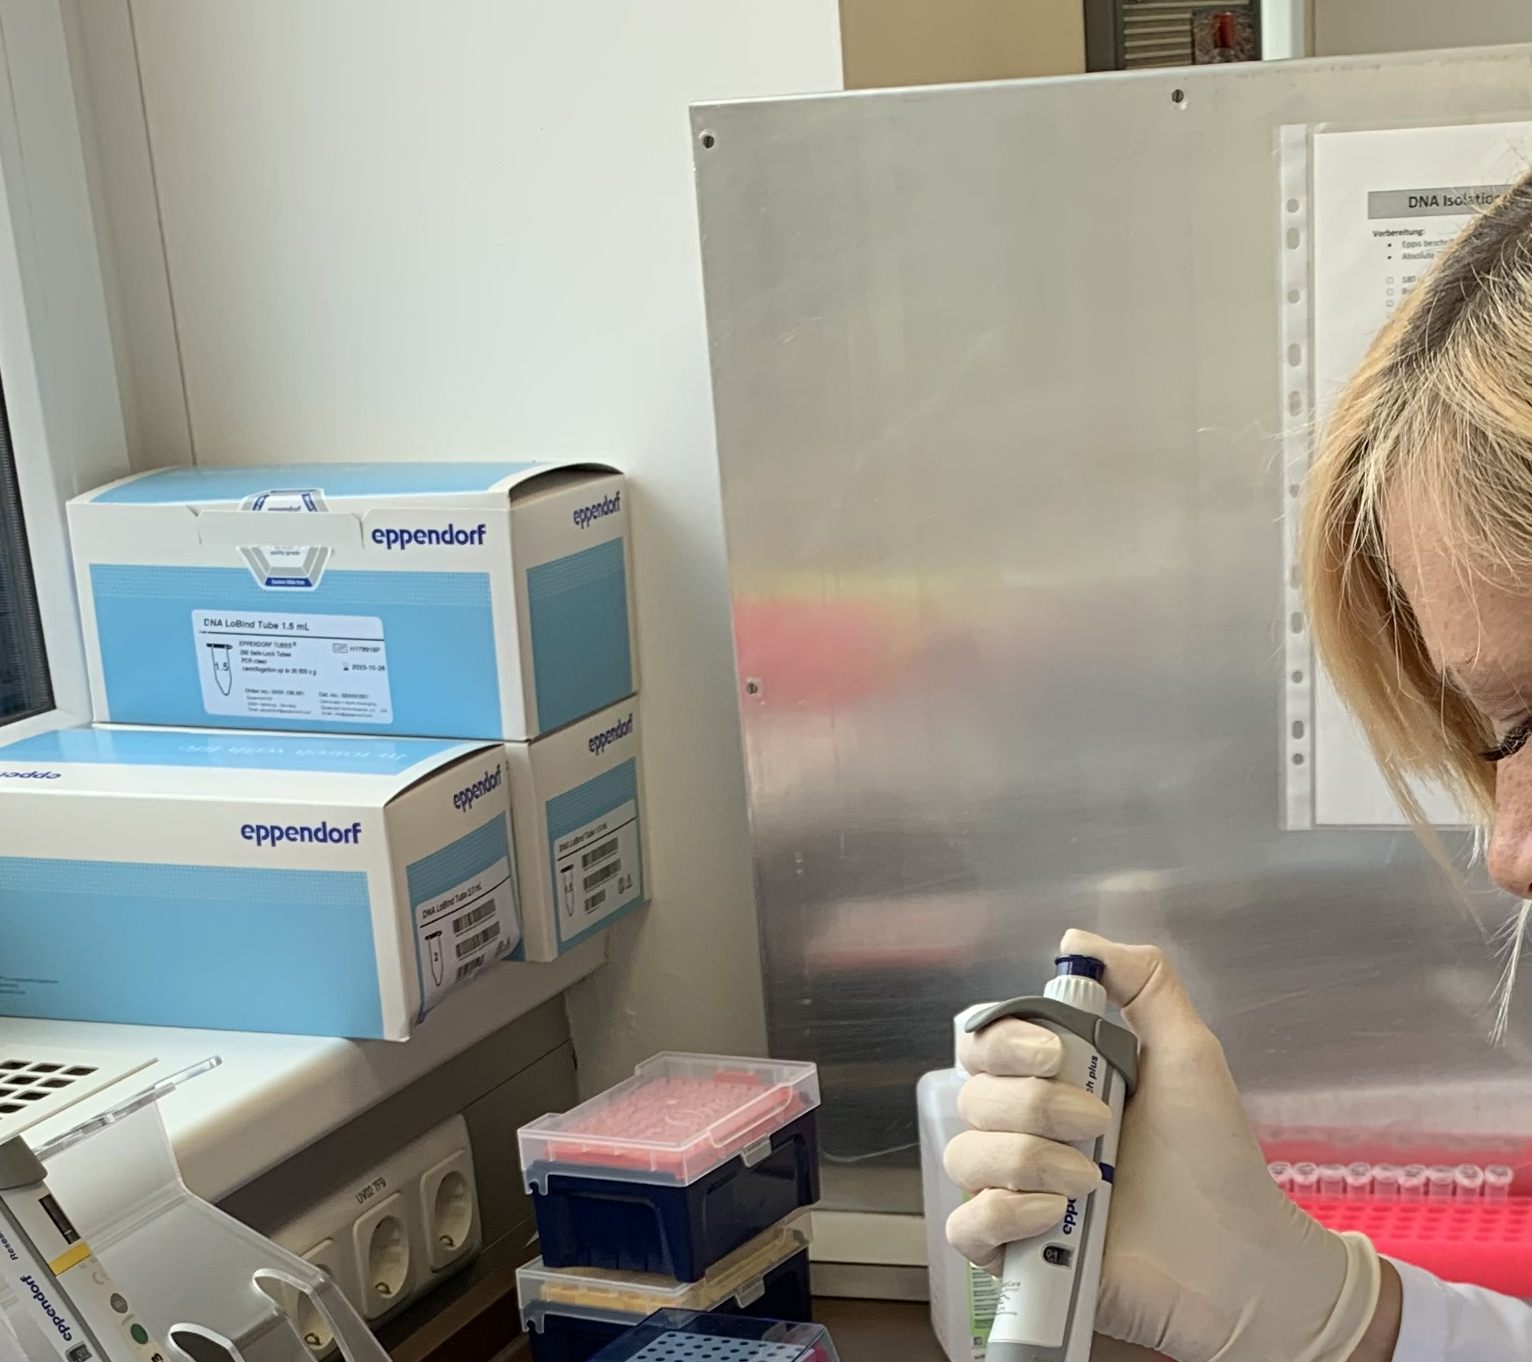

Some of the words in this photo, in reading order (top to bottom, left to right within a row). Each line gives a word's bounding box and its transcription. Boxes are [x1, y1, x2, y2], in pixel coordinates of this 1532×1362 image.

[1408, 195, 1440, 208] DNA
[573, 490, 621, 529] eppendorf
[371, 524, 486, 550] eppendorf
[204, 618, 223, 627] DNA
[225, 619, 256, 629] LoBind
[258, 620, 279, 630] Tube
[282, 622, 295, 630] 1.5
[296, 622, 310, 631] mL
[214, 662, 230, 672] 1.5
[588, 713, 633, 756] eppendorf
[453, 764, 502, 812] eppendorf
[241, 821, 362, 847] eppendorf
[434, 952, 439, 962] 2
[1087, 1055, 1098, 1080] plus
[19, 1274, 73, 1342] eppendorf
